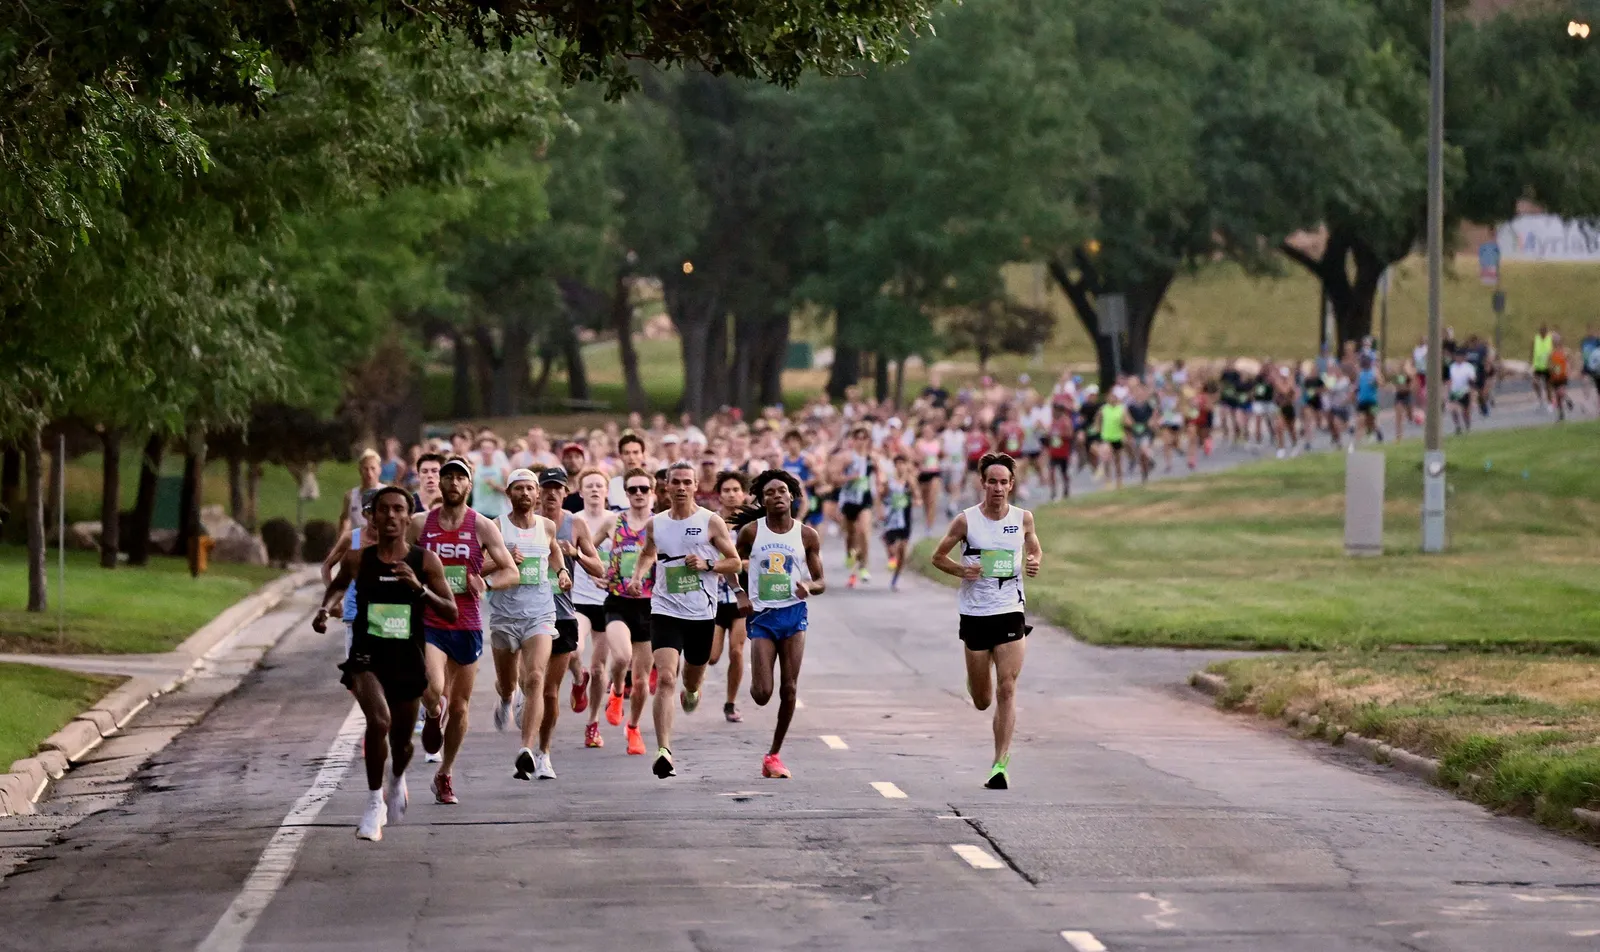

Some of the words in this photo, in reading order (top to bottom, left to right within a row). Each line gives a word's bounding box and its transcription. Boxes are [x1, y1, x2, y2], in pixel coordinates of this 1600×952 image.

[426, 542, 470, 559] USA
[993, 560, 1012, 569] 4246
[677, 575, 697, 584] 4430
[770, 583, 789, 592] 4902
[384, 617, 407, 628] 4100
